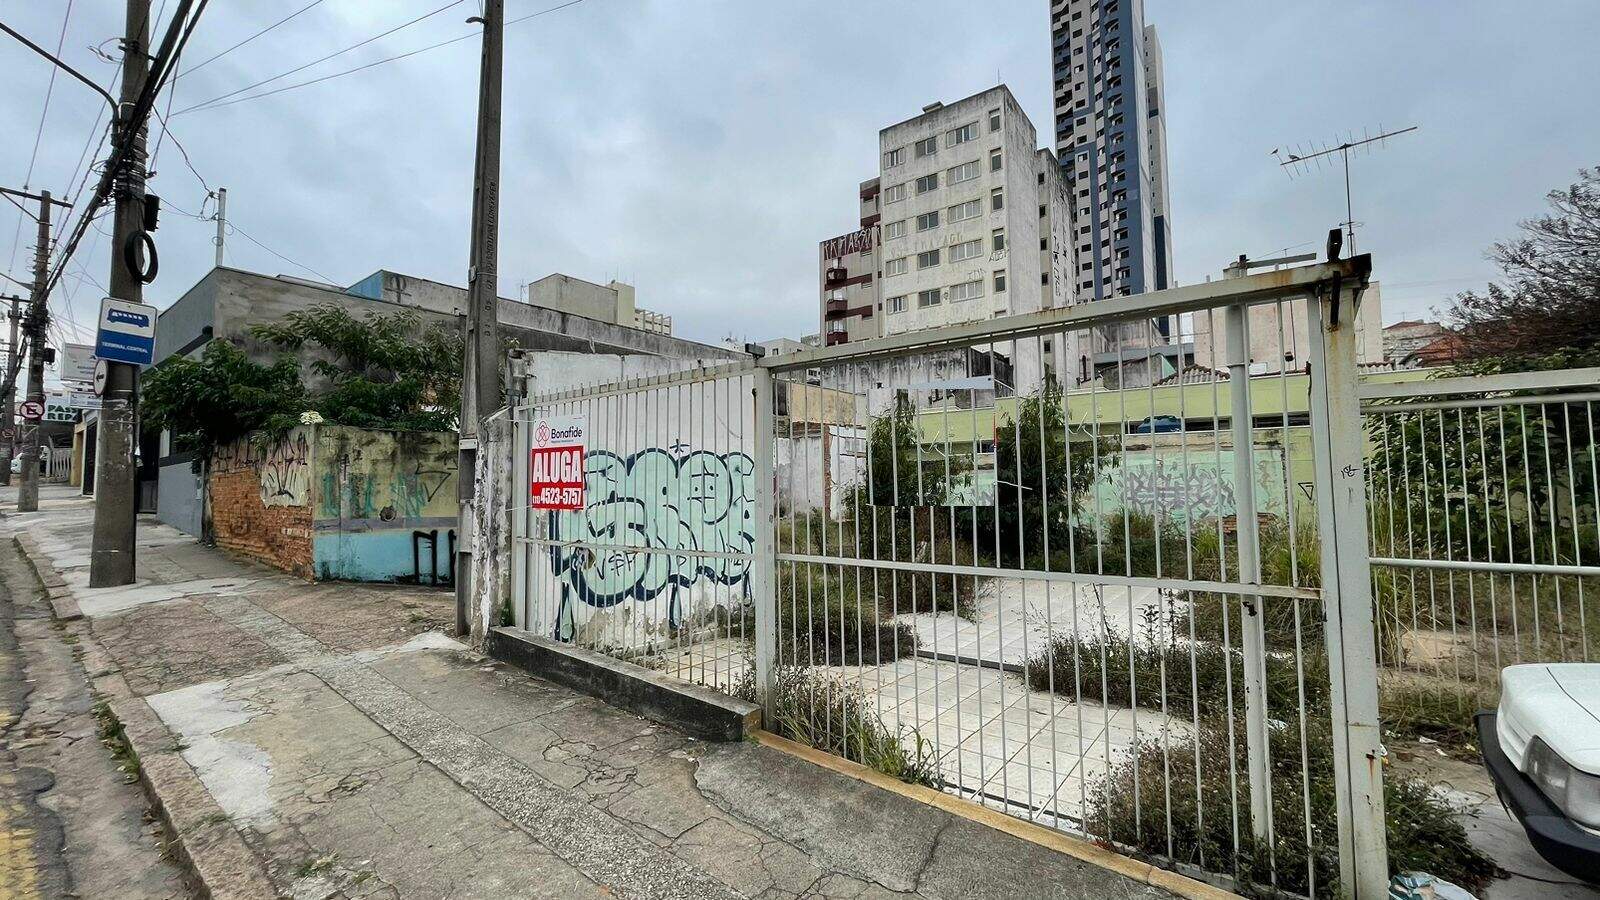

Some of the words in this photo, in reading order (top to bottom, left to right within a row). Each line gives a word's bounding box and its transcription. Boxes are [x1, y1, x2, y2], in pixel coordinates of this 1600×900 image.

[102, 341, 127, 350] TERMINAL
[551, 425, 583, 439] Bonafide
[533, 450, 582, 484] ALUGA
[540, 487, 582, 505] 4523-5757
